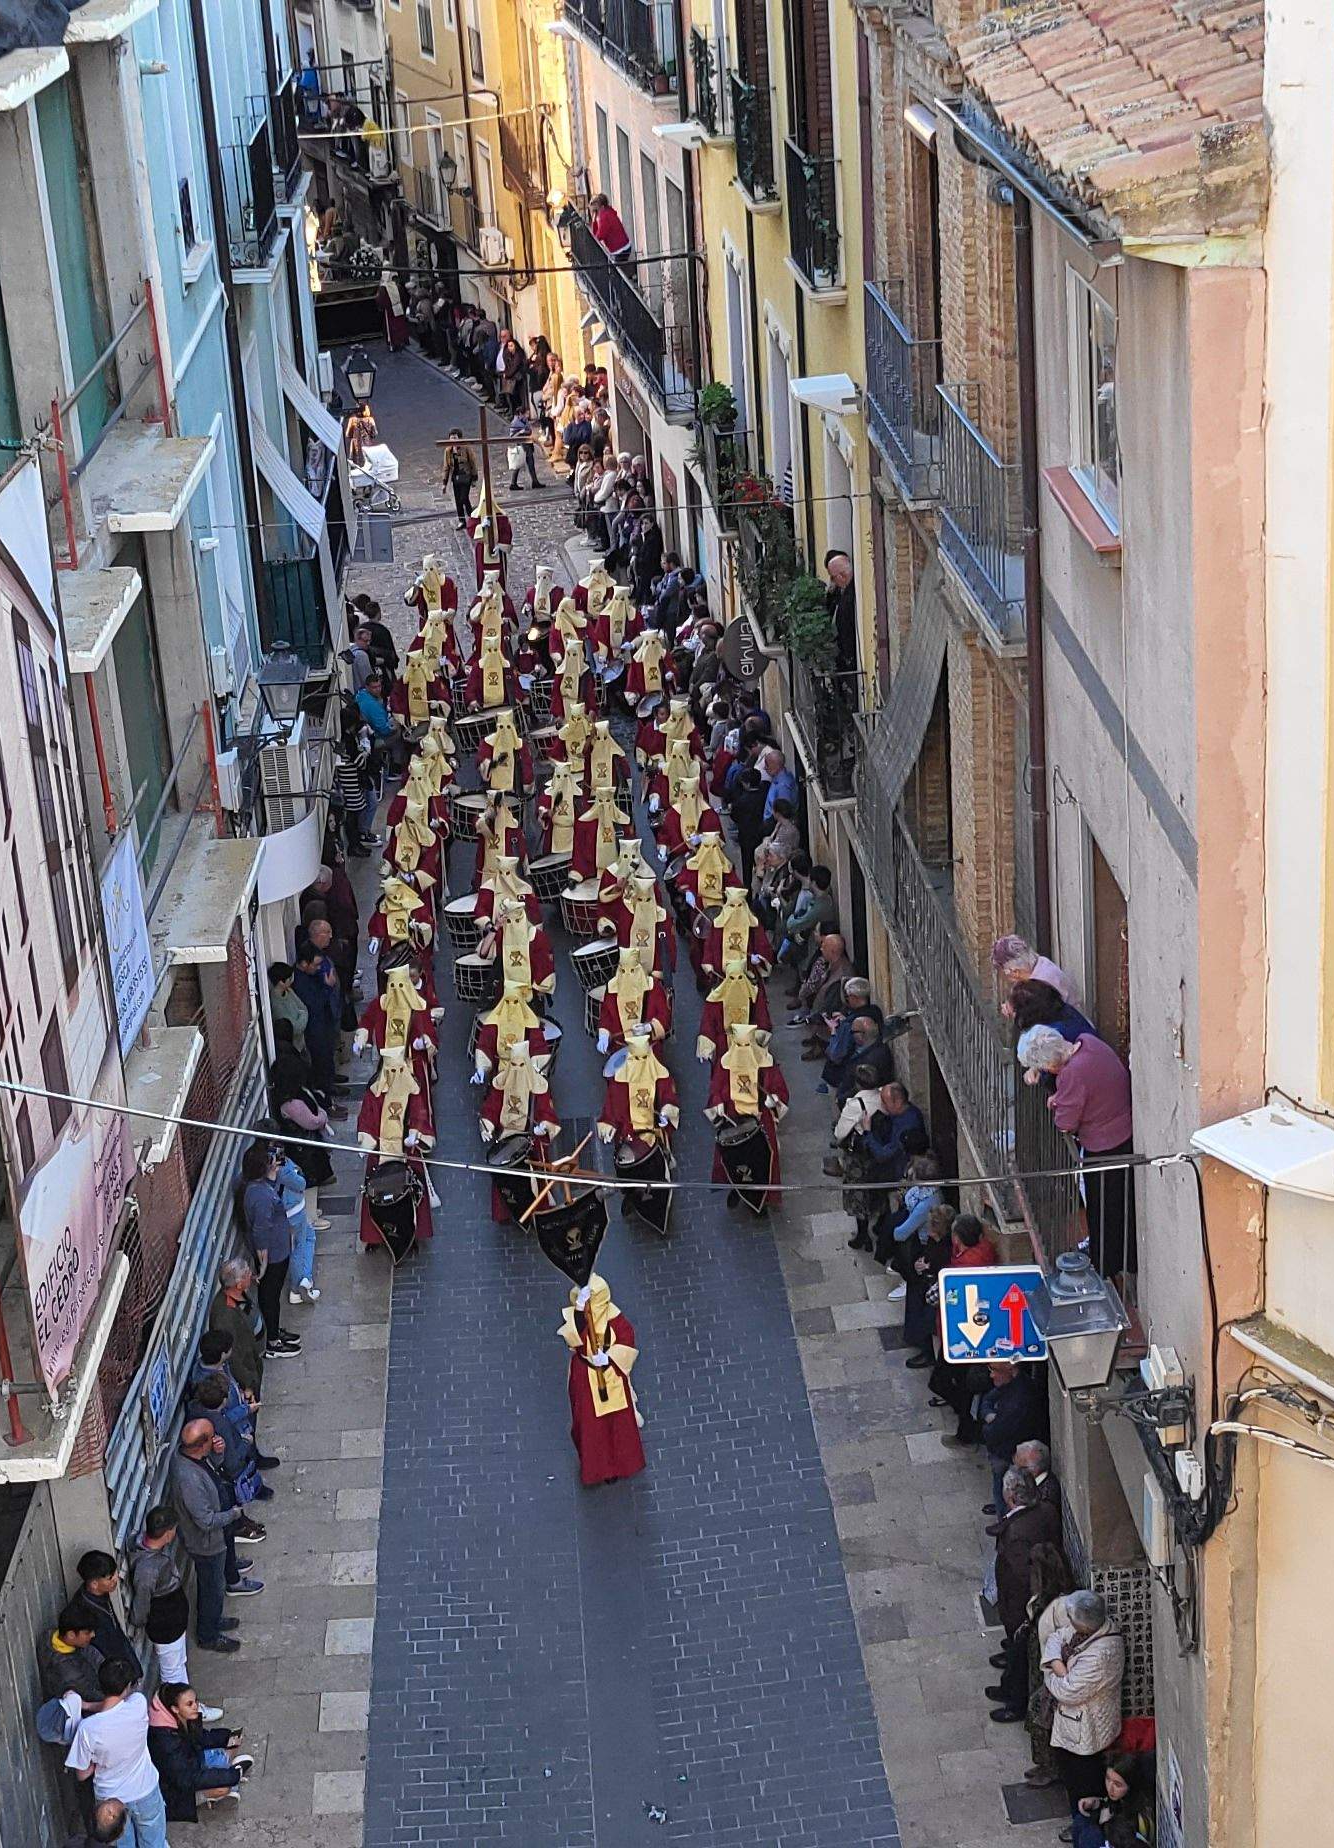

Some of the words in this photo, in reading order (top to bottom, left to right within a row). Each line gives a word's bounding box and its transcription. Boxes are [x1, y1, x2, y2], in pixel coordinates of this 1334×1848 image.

[34, 1225, 72, 1321] EDIFICIO
[37, 1317, 52, 1351] EL
[51, 1246, 80, 1324] CEDRO
